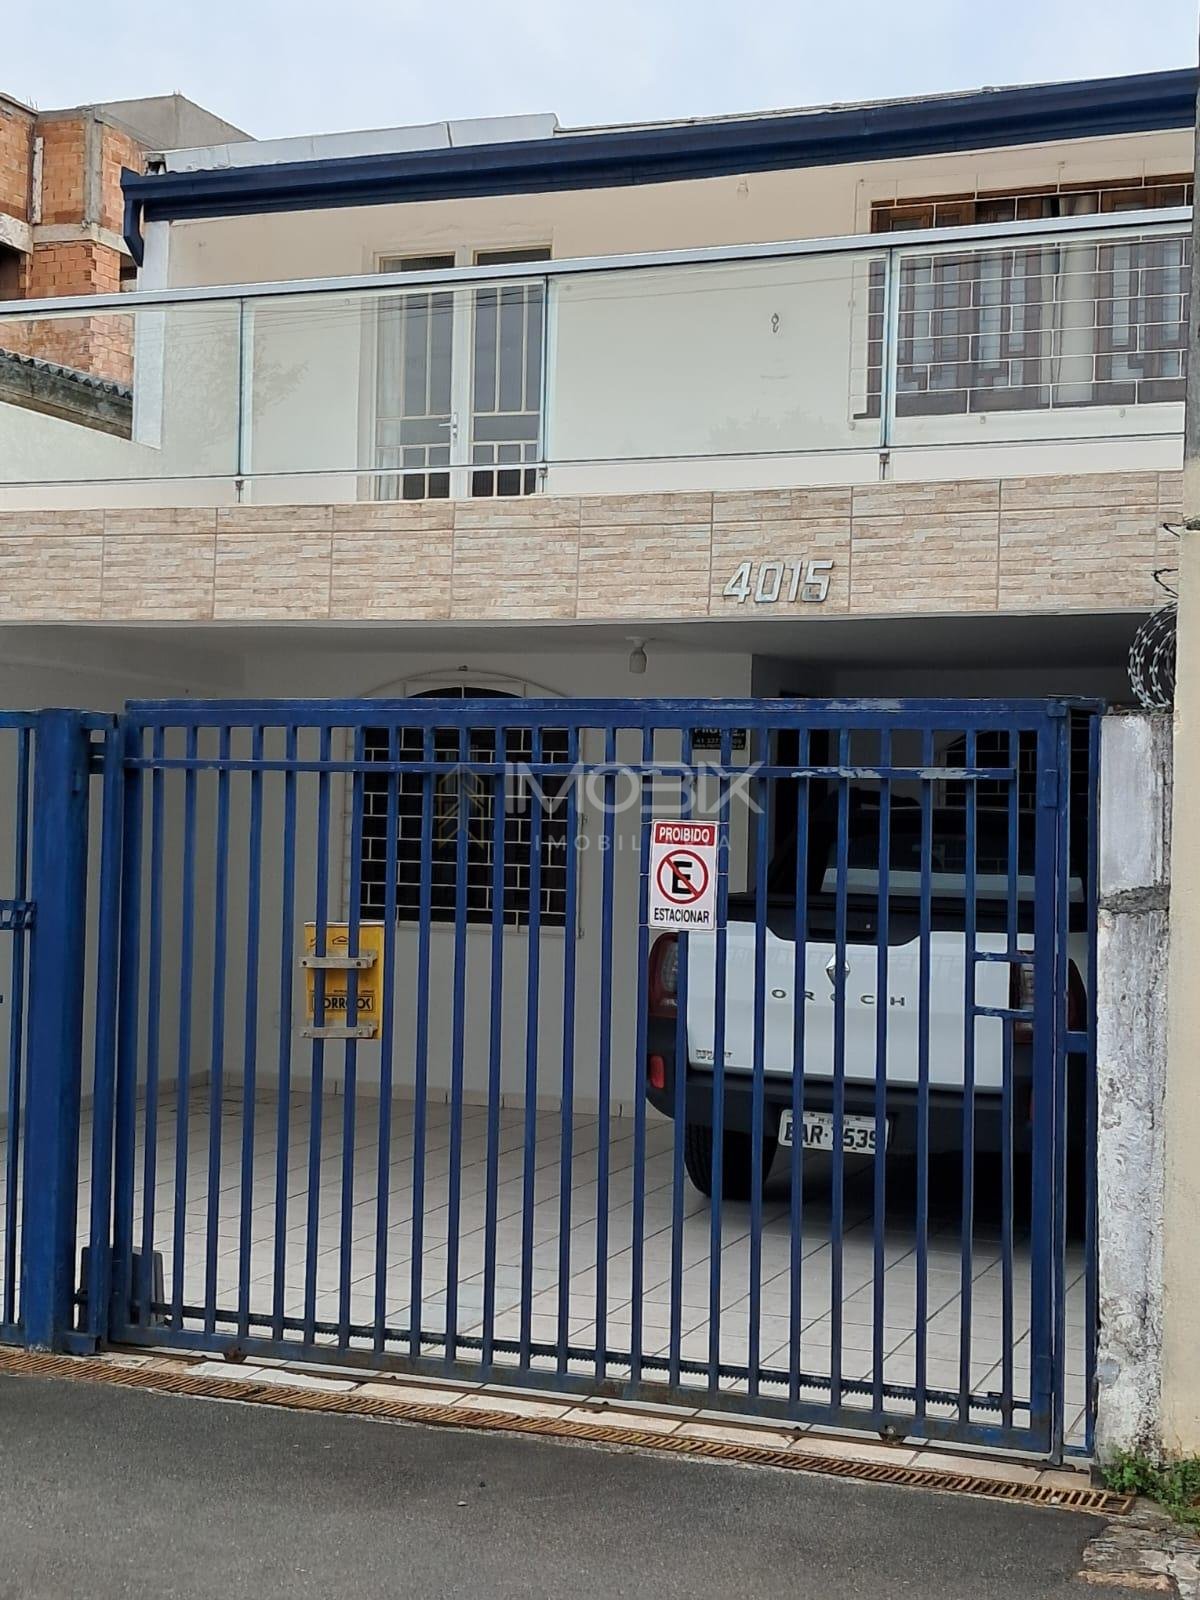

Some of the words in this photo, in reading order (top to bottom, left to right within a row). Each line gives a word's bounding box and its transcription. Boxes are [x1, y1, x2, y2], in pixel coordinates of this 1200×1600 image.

[722, 560, 834, 603] 4015
[659, 826, 710, 843] PROIBIDO
[672, 860, 693, 895] E
[654, 907, 710, 924] ESTACIONAR
